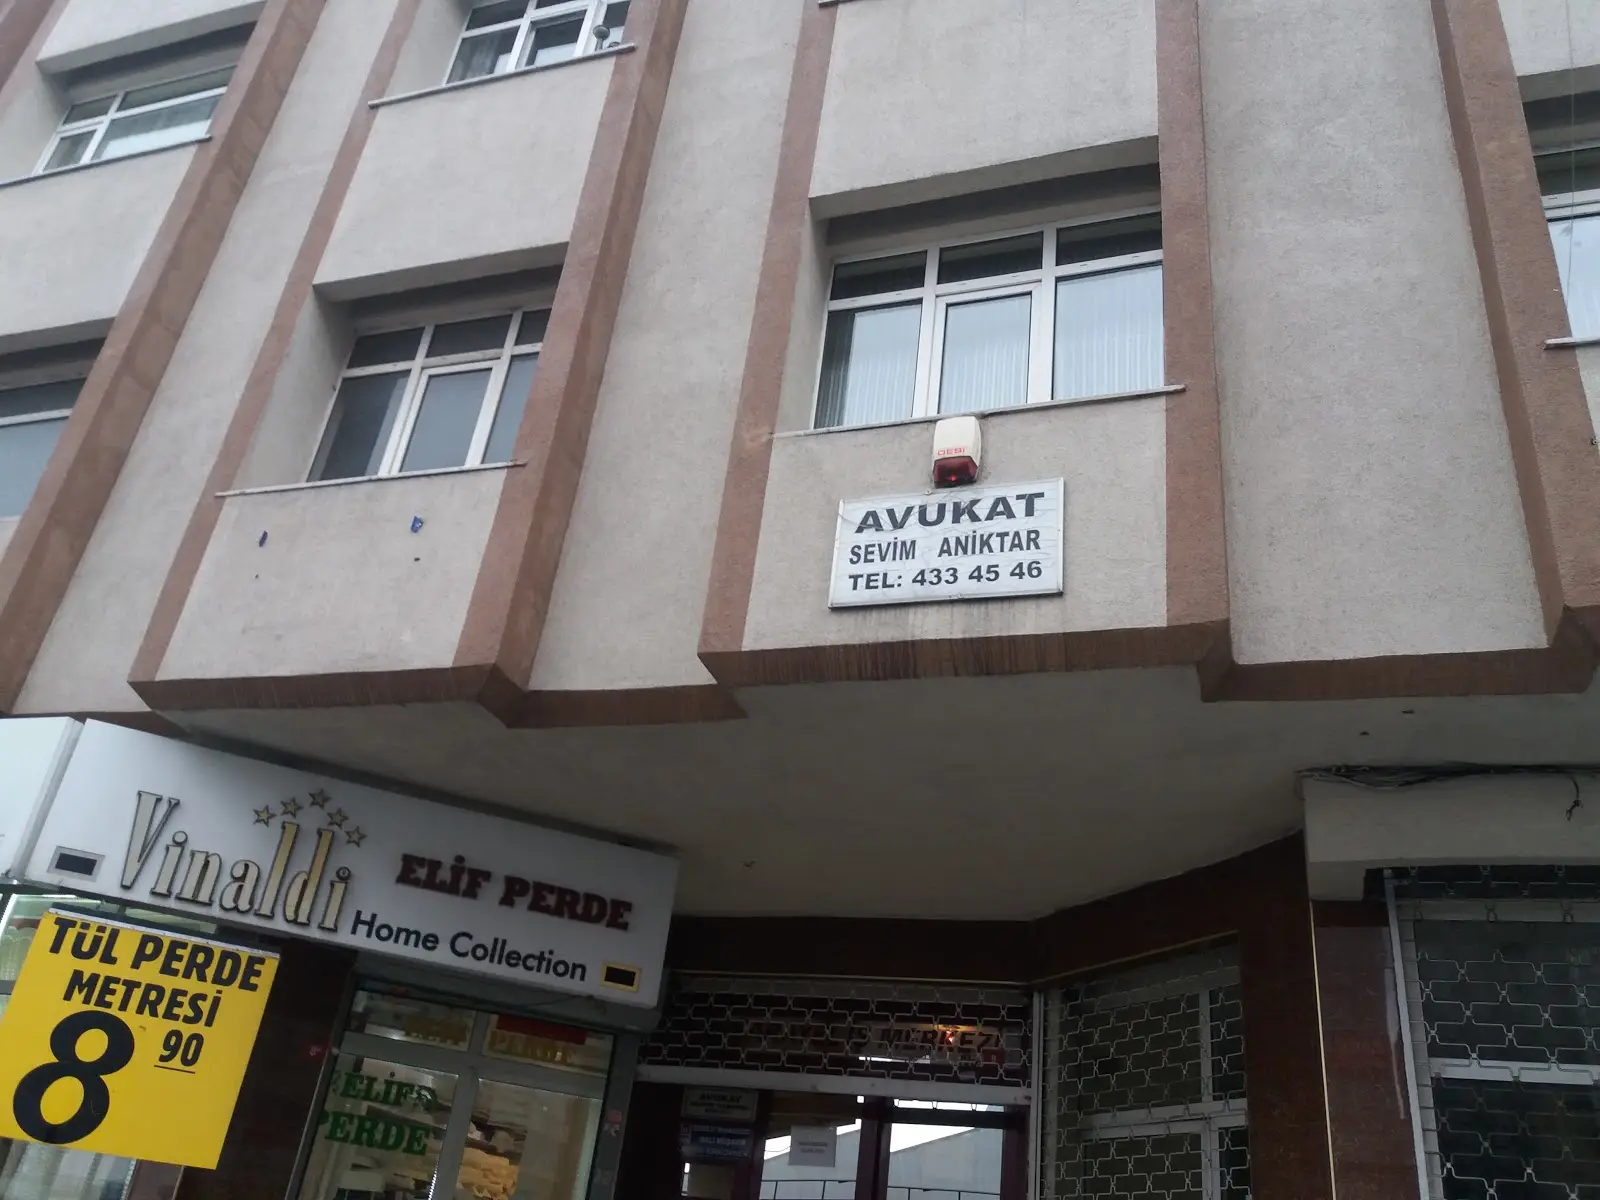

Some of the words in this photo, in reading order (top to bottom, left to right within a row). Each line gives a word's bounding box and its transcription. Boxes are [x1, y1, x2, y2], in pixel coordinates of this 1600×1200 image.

[849, 537, 916, 565] SEVİM
[937, 529, 1041, 557] ANİKTAR
[855, 492, 1045, 533] AVUKAT
[848, 572, 902, 591] TEL:
[911, 567, 959, 587] 433
[968, 564, 1000, 583] 45
[1009, 560, 1043, 580] 46
[120, 790, 352, 932] Vinaldi
[395, 854, 492, 900] ELİF
[498, 875, 633, 931] PERDE
[49, 917, 121, 965] TÜL
[130, 934, 266, 992] PERDE
[350, 910, 440, 951] Home
[449, 931, 587, 982] Collection
[62, 968, 223, 1028] METRESİ
[13, 1010, 135, 1145] 8
[158, 1029, 204, 1068] 90
